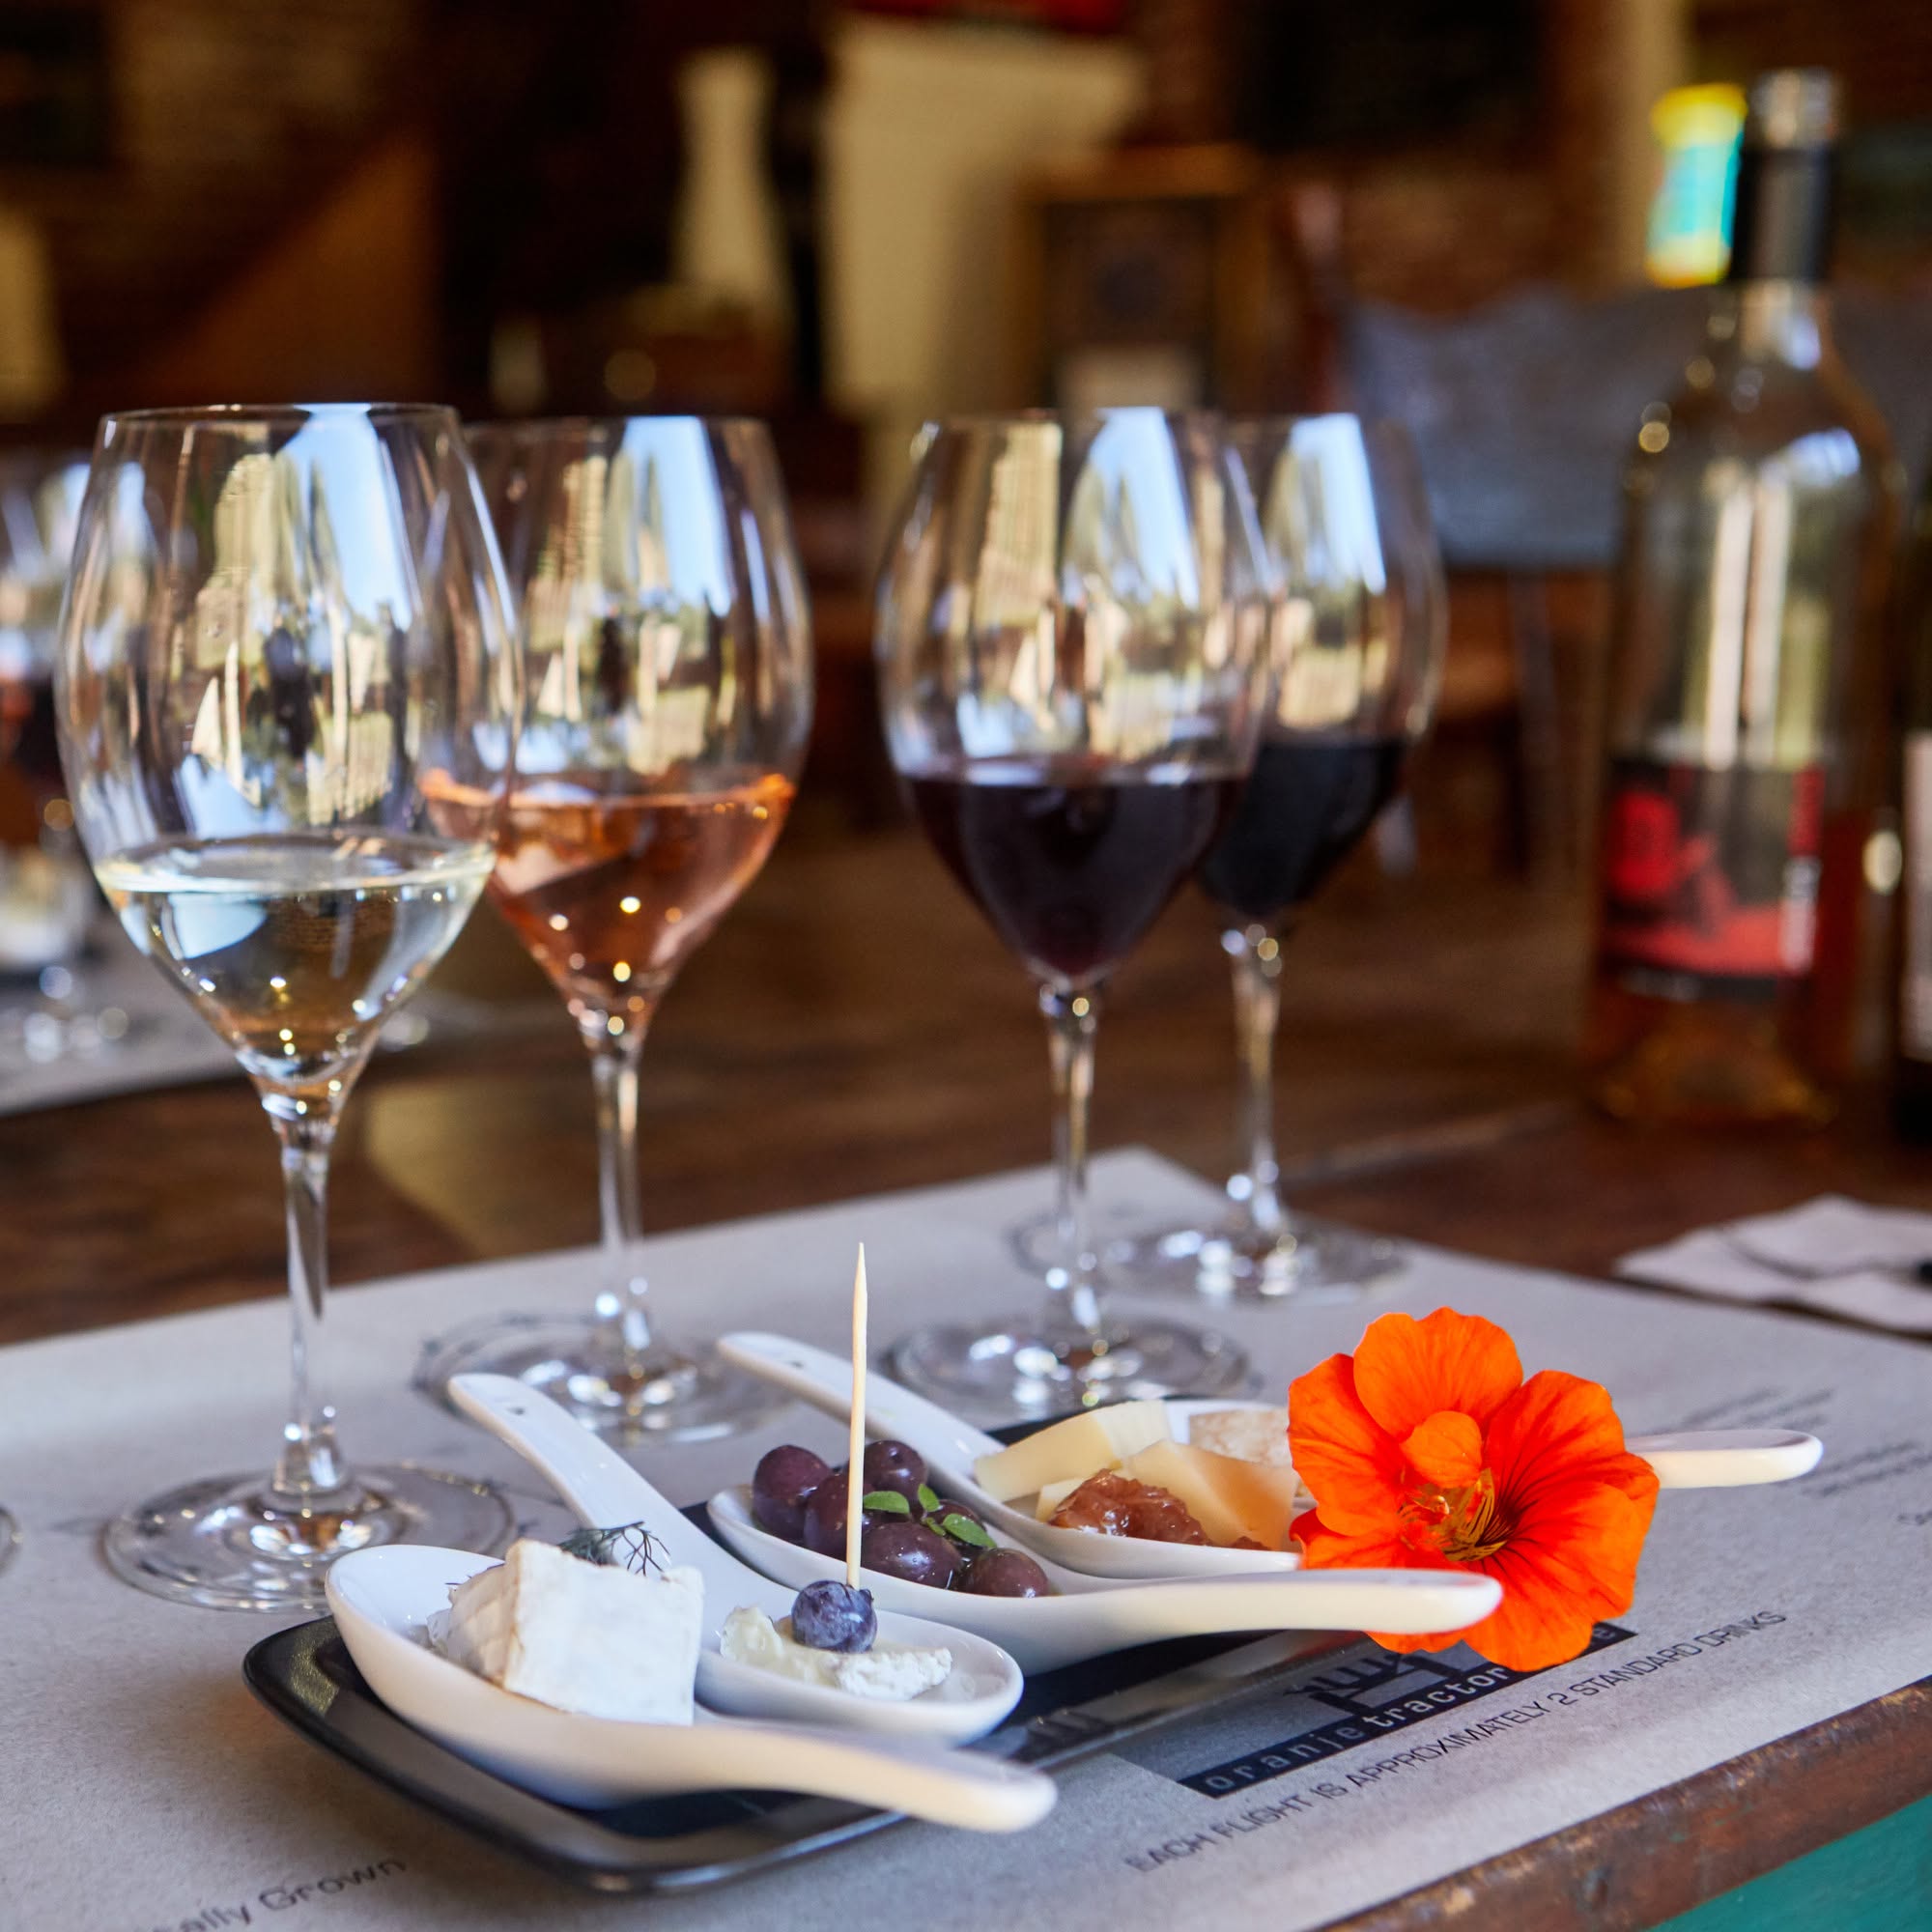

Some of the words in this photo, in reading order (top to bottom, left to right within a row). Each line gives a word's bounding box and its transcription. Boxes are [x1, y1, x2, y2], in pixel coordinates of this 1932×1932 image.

[1124, 1833, 1216, 1872] EACH
[1210, 1794, 1313, 1838] FLIGHT
[1310, 1782, 1349, 1799] IS
[1346, 1701, 1550, 1787] APPROXIMATELY
[1547, 1692, 1577, 1706] 2
[1569, 1643, 1702, 1696] STANDARD
[1693, 1610, 1786, 1647] DRINKS
[1205, 1725, 1364, 1790] oranje
[1362, 1666, 1509, 1727] tractor
[153, 1905, 251, 1932] ally
[258, 1860, 407, 1910] Grown
